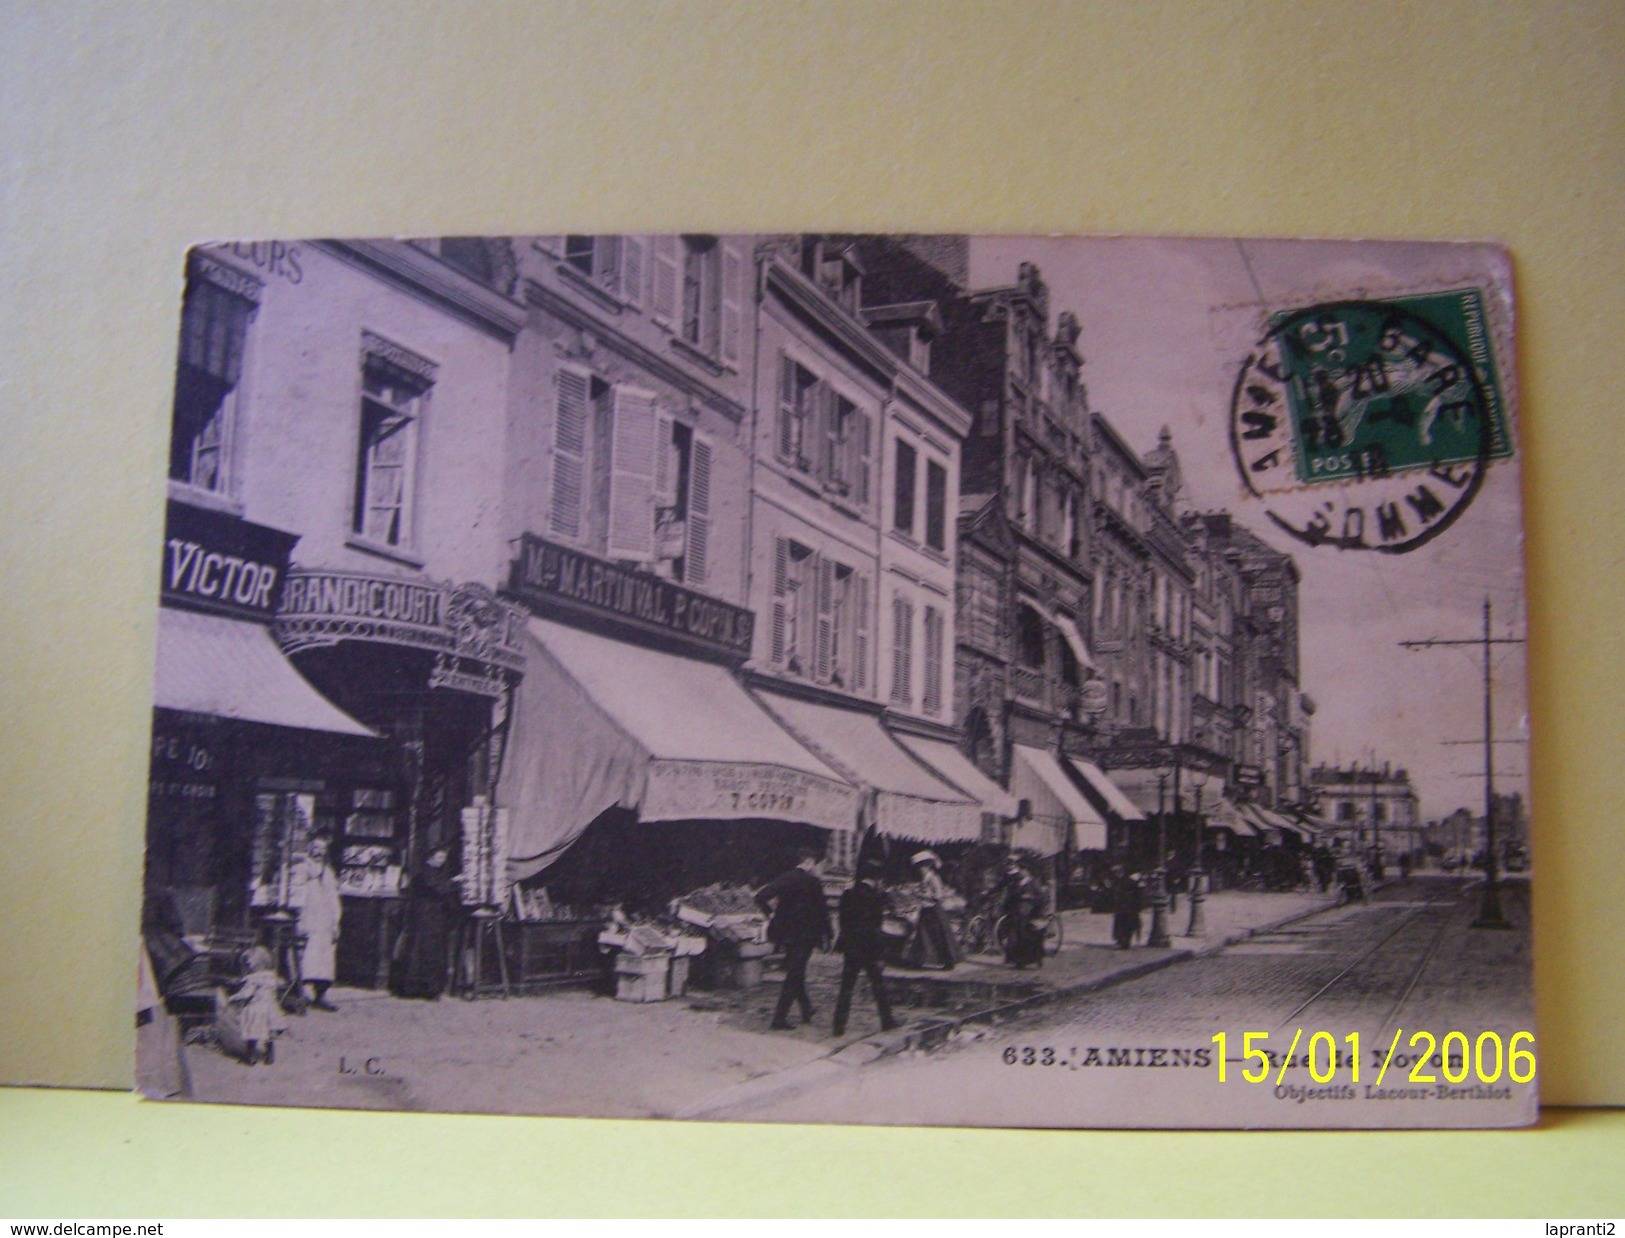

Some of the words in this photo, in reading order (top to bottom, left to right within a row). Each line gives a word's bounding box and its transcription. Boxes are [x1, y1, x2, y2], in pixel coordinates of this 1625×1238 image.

[167, 539, 278, 609] VICTOR
[1002, 1046, 1069, 1066] 633.
[1083, 1047, 1213, 1068] AMIENS
[1274, 1083, 1356, 1104] Objectifs
